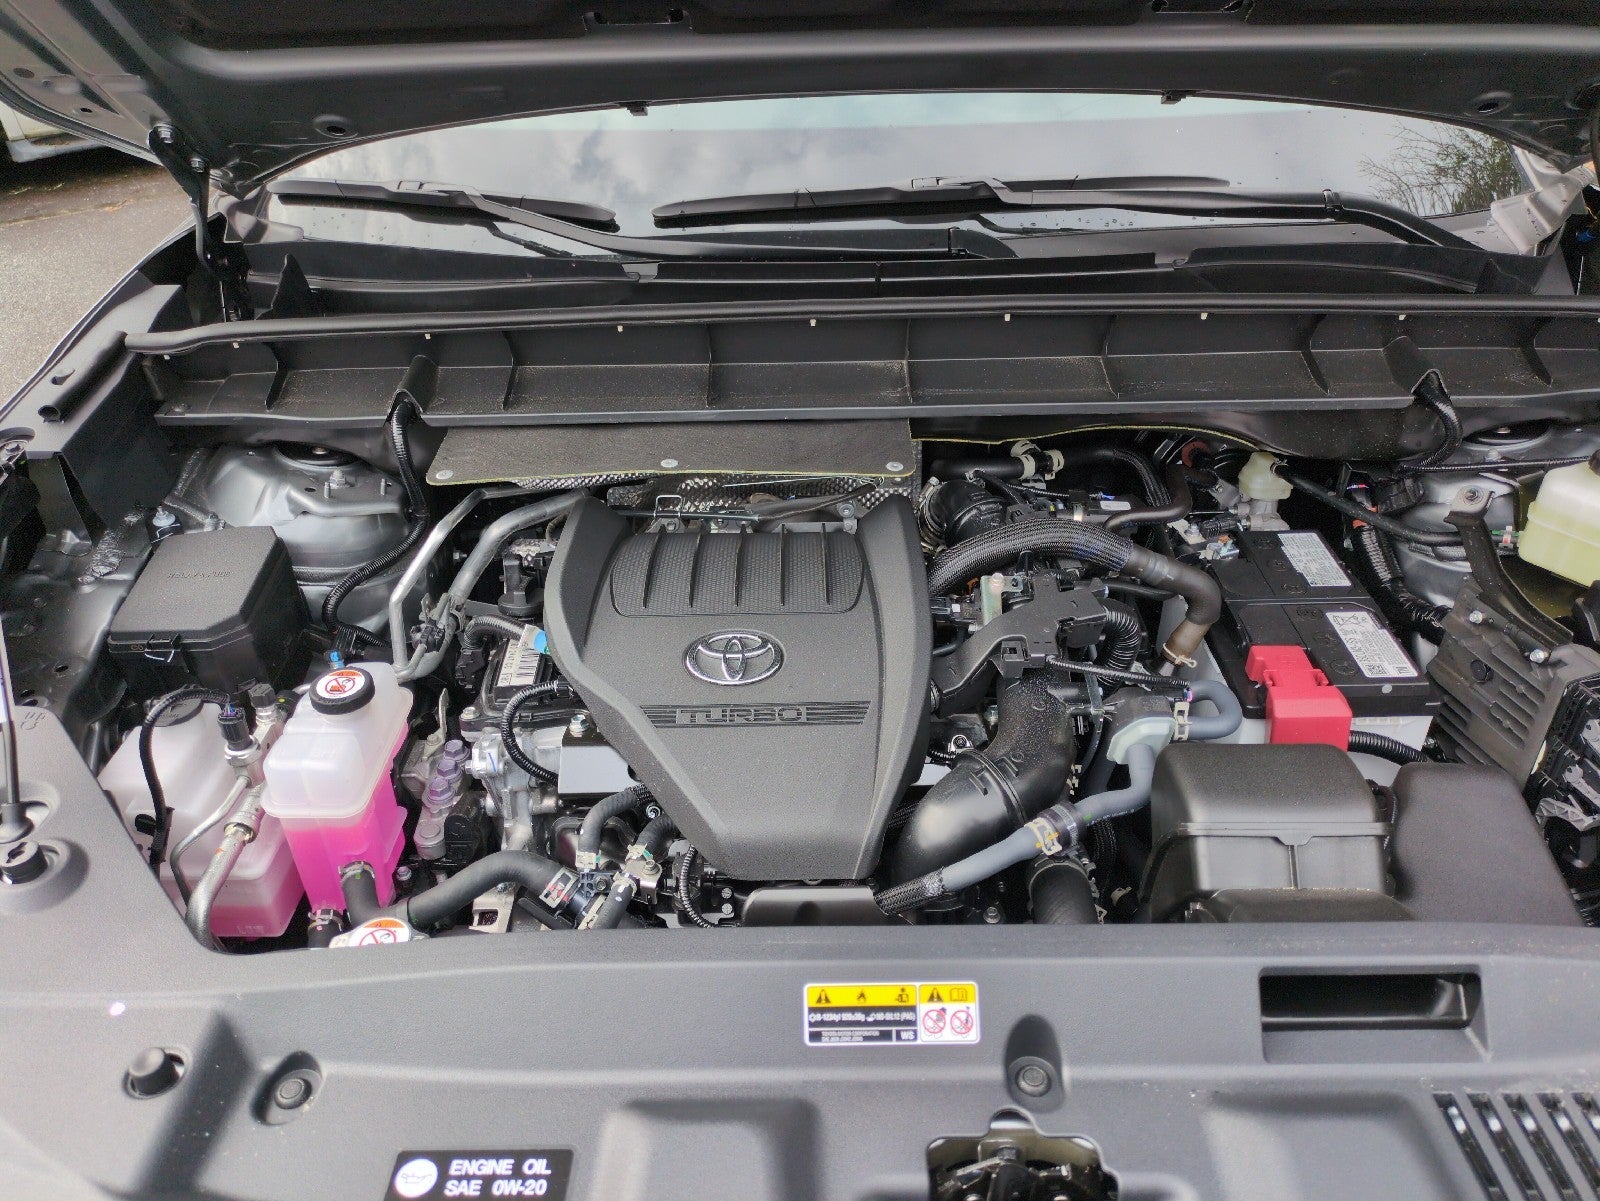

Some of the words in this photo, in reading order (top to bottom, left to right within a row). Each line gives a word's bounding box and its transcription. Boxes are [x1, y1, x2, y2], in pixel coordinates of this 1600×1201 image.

[679, 708, 803, 723] TURBO
[901, 1031, 915, 1040] WS
[449, 1158, 515, 1175] ENGINE
[522, 1158, 552, 1175] OIL
[444, 1179, 483, 1196] SAE
[492, 1179, 547, 1196] 0W-20
